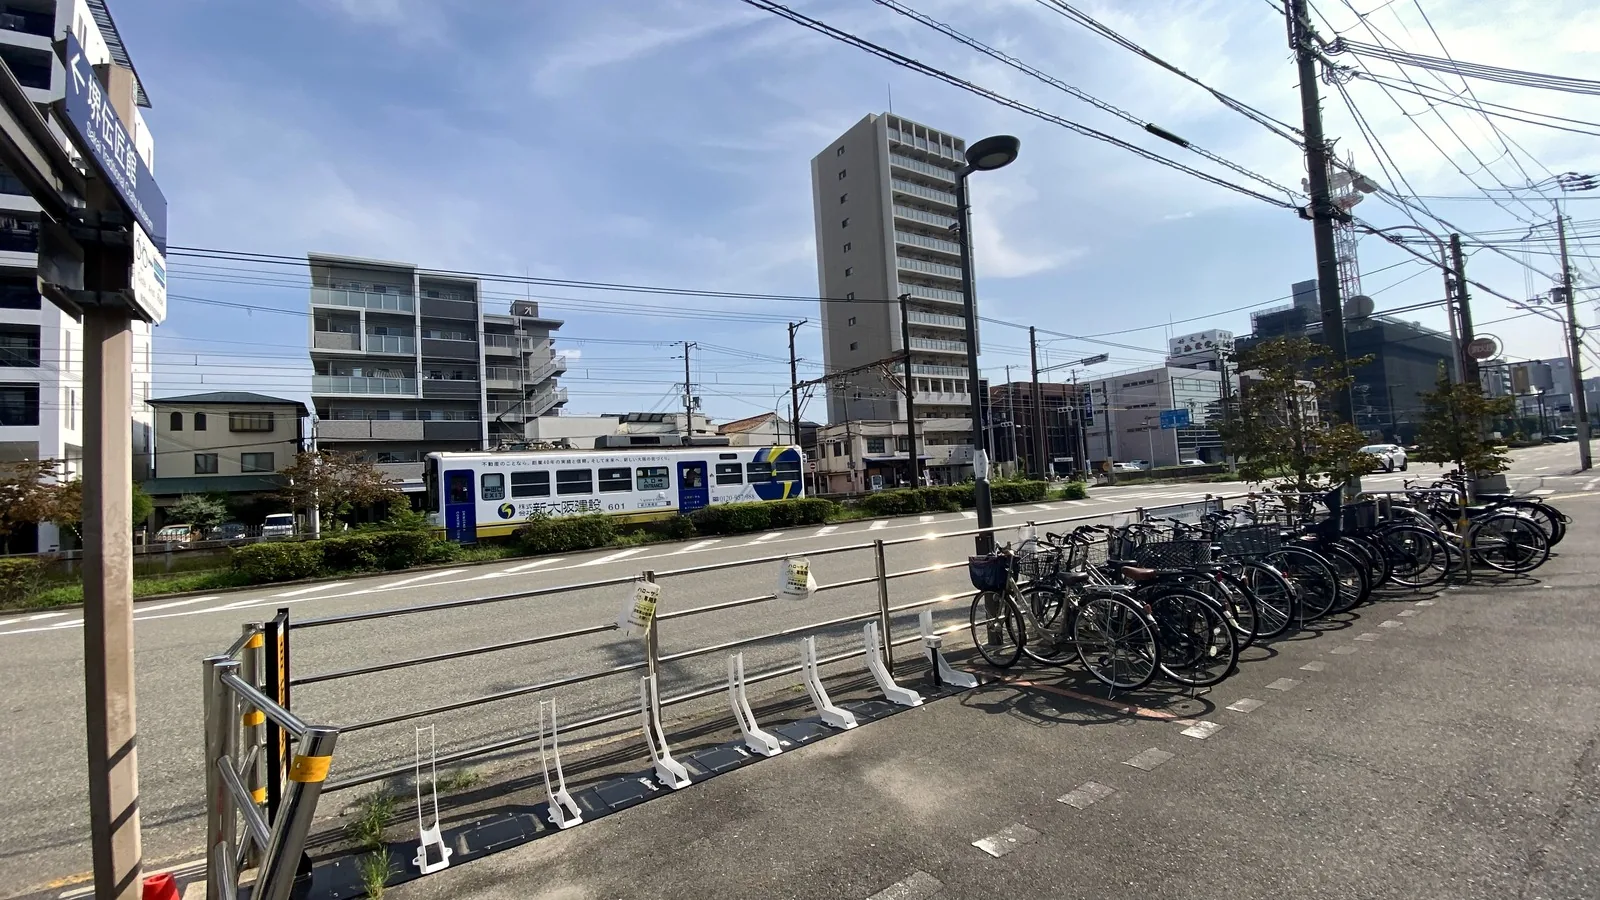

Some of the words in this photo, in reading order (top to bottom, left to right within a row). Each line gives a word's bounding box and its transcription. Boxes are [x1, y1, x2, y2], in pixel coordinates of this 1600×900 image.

[87, 73, 137, 189] 堺伝匠館
[86, 121, 102, 154] Sakai
[101, 143, 125, 189] Traditional
[532, 498, 602, 516] 新大阪建設
[608, 503, 626, 511] 601
